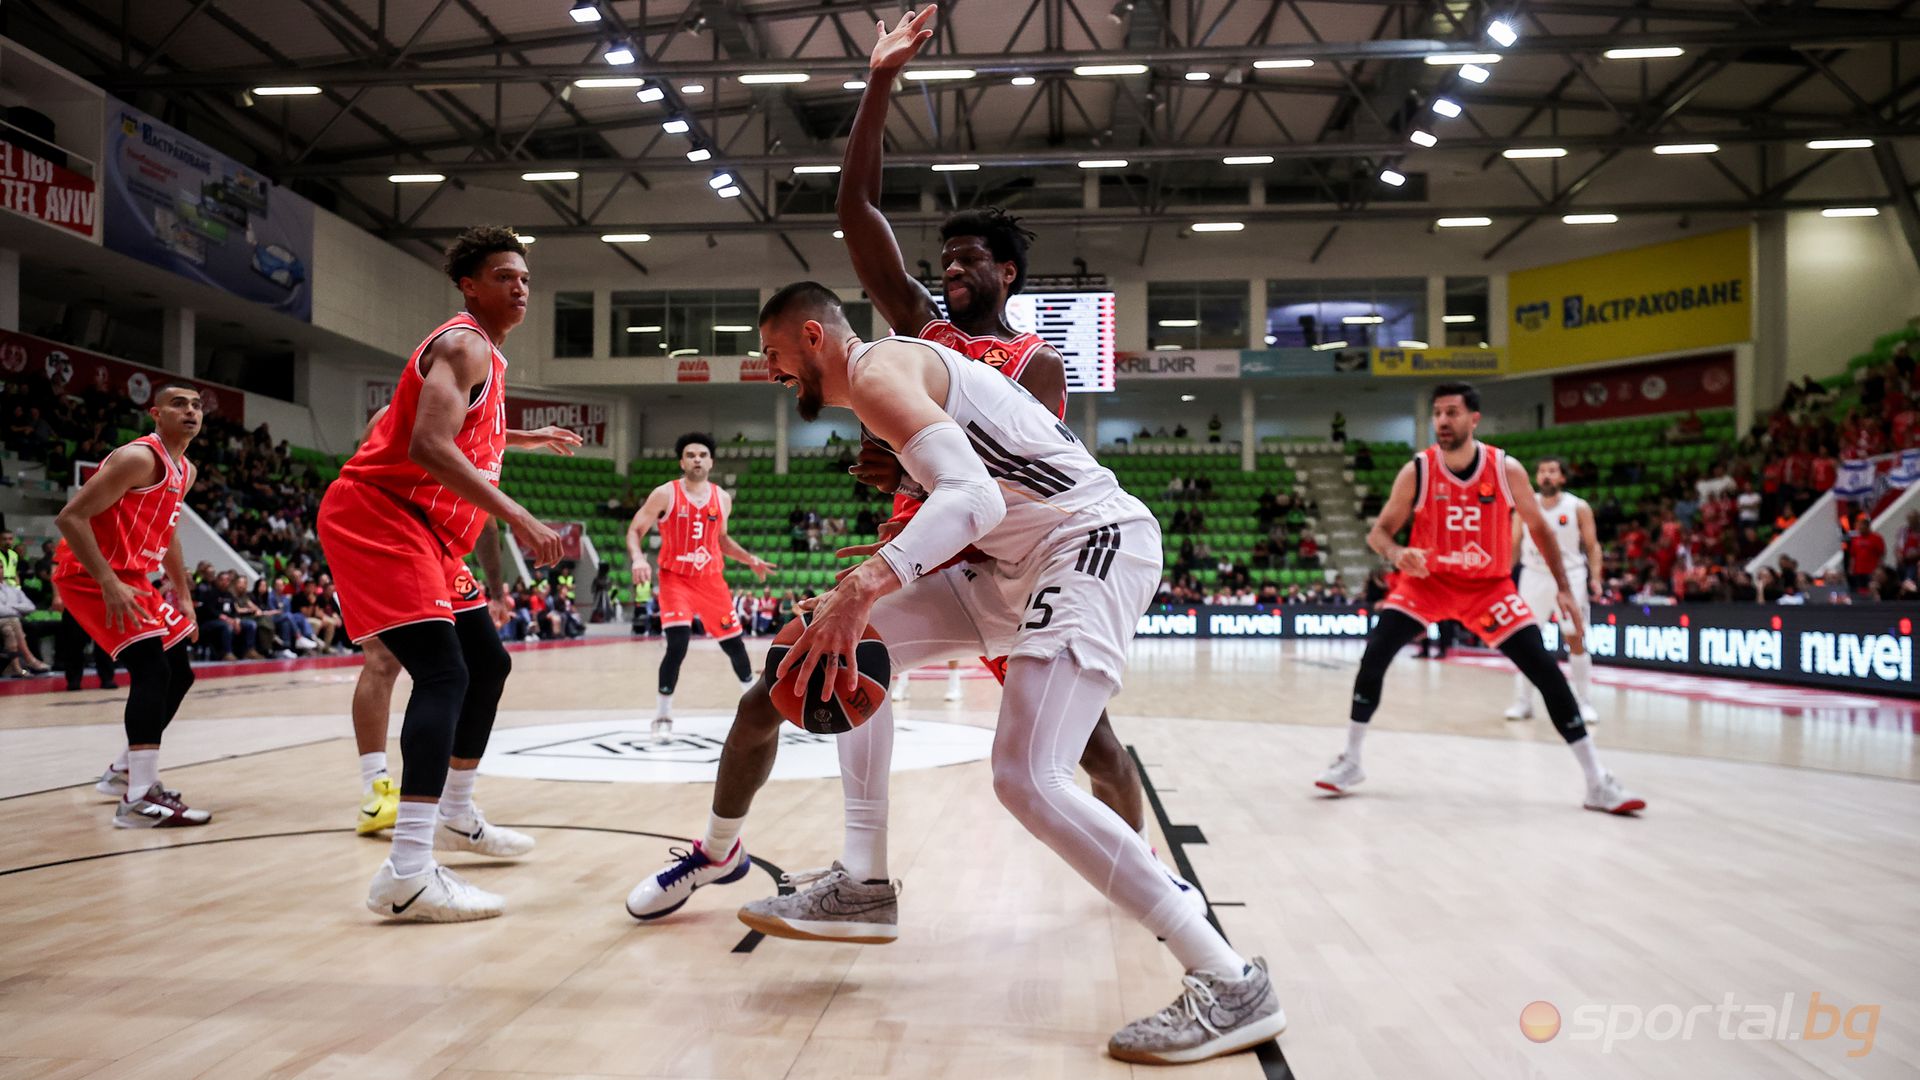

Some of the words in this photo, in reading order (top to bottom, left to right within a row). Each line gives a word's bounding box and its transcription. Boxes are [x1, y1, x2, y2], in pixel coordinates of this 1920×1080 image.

[44, 185, 95, 226] AVIV
[1563, 279, 1742, 330] ЗАСТРАХОВАНЕ
[522, 403, 585, 431] HAPOEL
[691, 521, 704, 540] 3
[1445, 505, 1482, 531] 22
[158, 602, 184, 627] 2
[730, 610, 741, 628] 3
[1210, 608, 1283, 636] nuvei
[1294, 608, 1369, 636] nuvei
[1489, 593, 1531, 626] 22
[1624, 614, 1690, 663] nuvei
[1700, 614, 1783, 671] nuvei
[1800, 617, 1913, 682] nuvei
